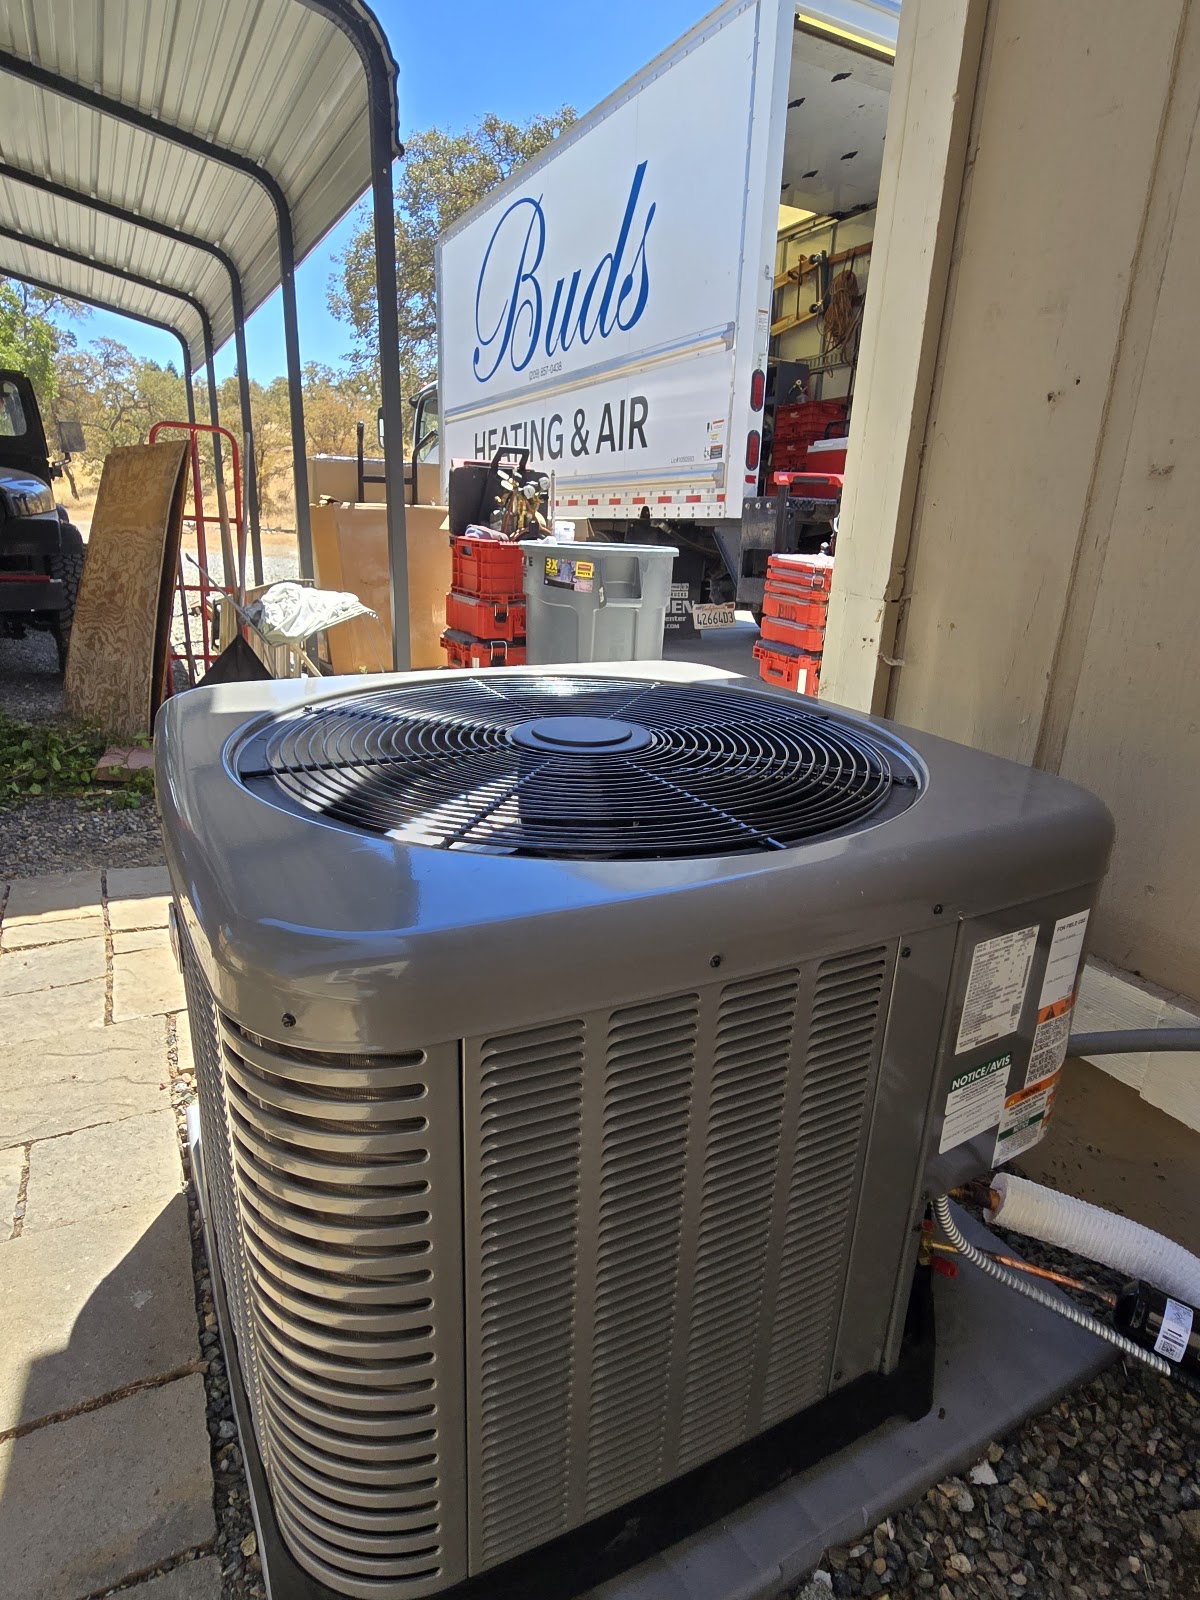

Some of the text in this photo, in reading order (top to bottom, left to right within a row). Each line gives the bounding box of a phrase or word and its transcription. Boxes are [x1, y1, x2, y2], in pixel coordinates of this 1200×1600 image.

[474, 395, 649, 462] HEATING & AIR
[545, 557, 559, 570] 3X
[696, 611, 734, 626] 42664D3
[951, 1054, 1011, 1091] NOTICE/AVIS
